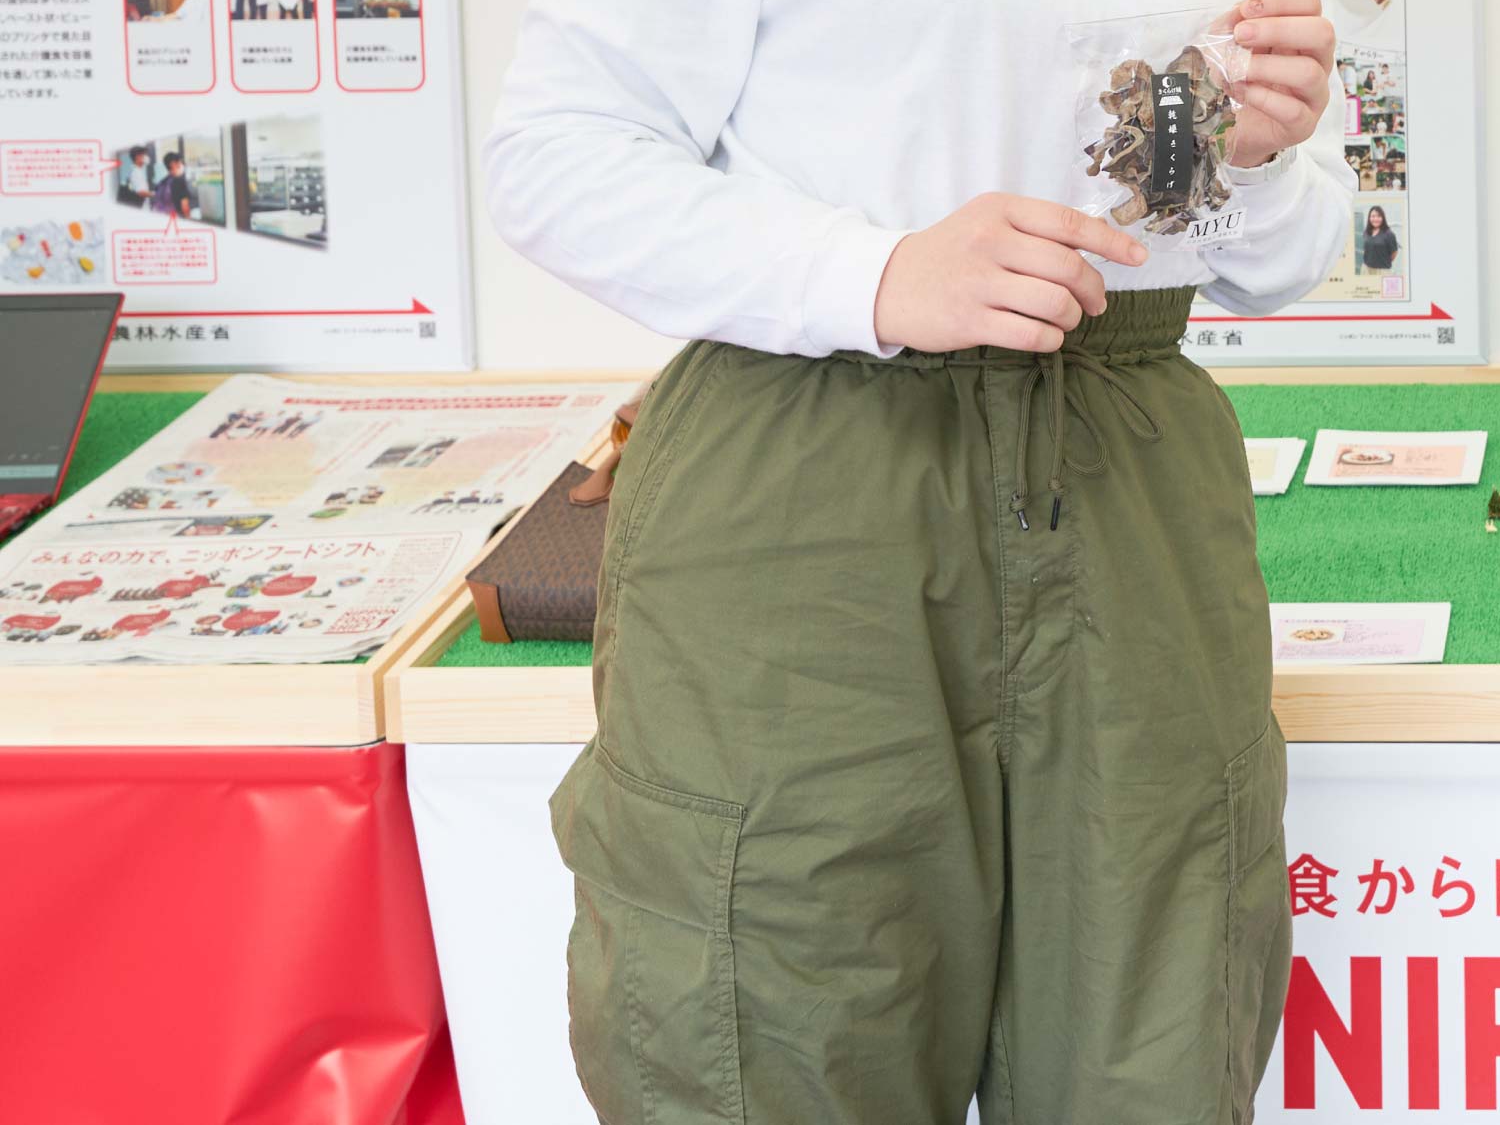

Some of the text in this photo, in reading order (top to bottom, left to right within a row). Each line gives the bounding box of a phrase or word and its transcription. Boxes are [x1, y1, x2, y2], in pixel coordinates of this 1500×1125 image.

[1189, 211, 1243, 238] MYU
[31, 542, 387, 565] みんなの力で、ニッポンフードシフト。
